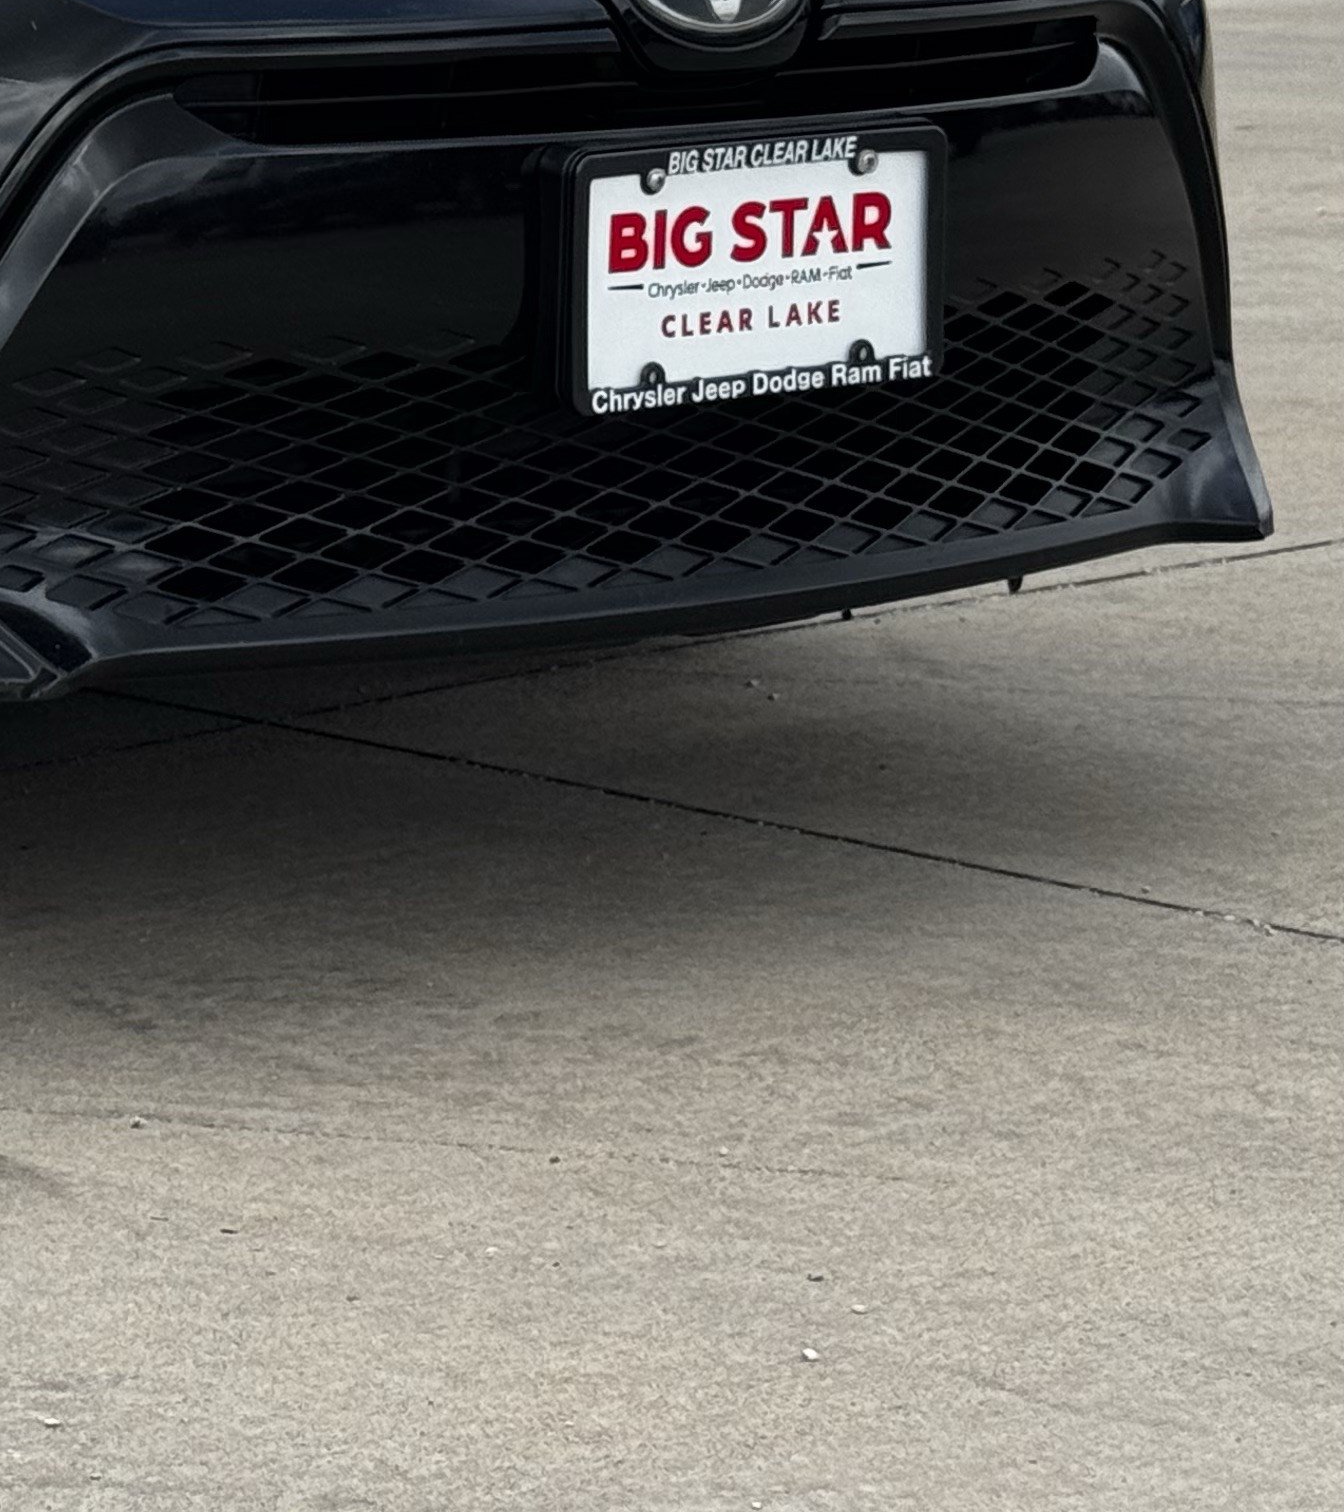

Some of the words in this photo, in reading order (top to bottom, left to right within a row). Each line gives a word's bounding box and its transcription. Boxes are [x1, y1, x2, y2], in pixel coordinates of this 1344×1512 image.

[668, 149, 699, 175] BIG
[702, 145, 747, 171] STAR
[750, 139, 808, 167] CLEAR
[812, 135, 857, 161] LAKE
[608, 206, 713, 274] BIG
[730, 191, 892, 262] STAR
[661, 307, 753, 338] CLEAR
[767, 299, 841, 328] LAKE
[591, 383, 687, 415] Chrysler
[692, 378, 746, 403] Jeep
[753, 366, 825, 395] Dodge
[831, 361, 881, 386] Ram
[888, 355, 933, 380] Fiat
